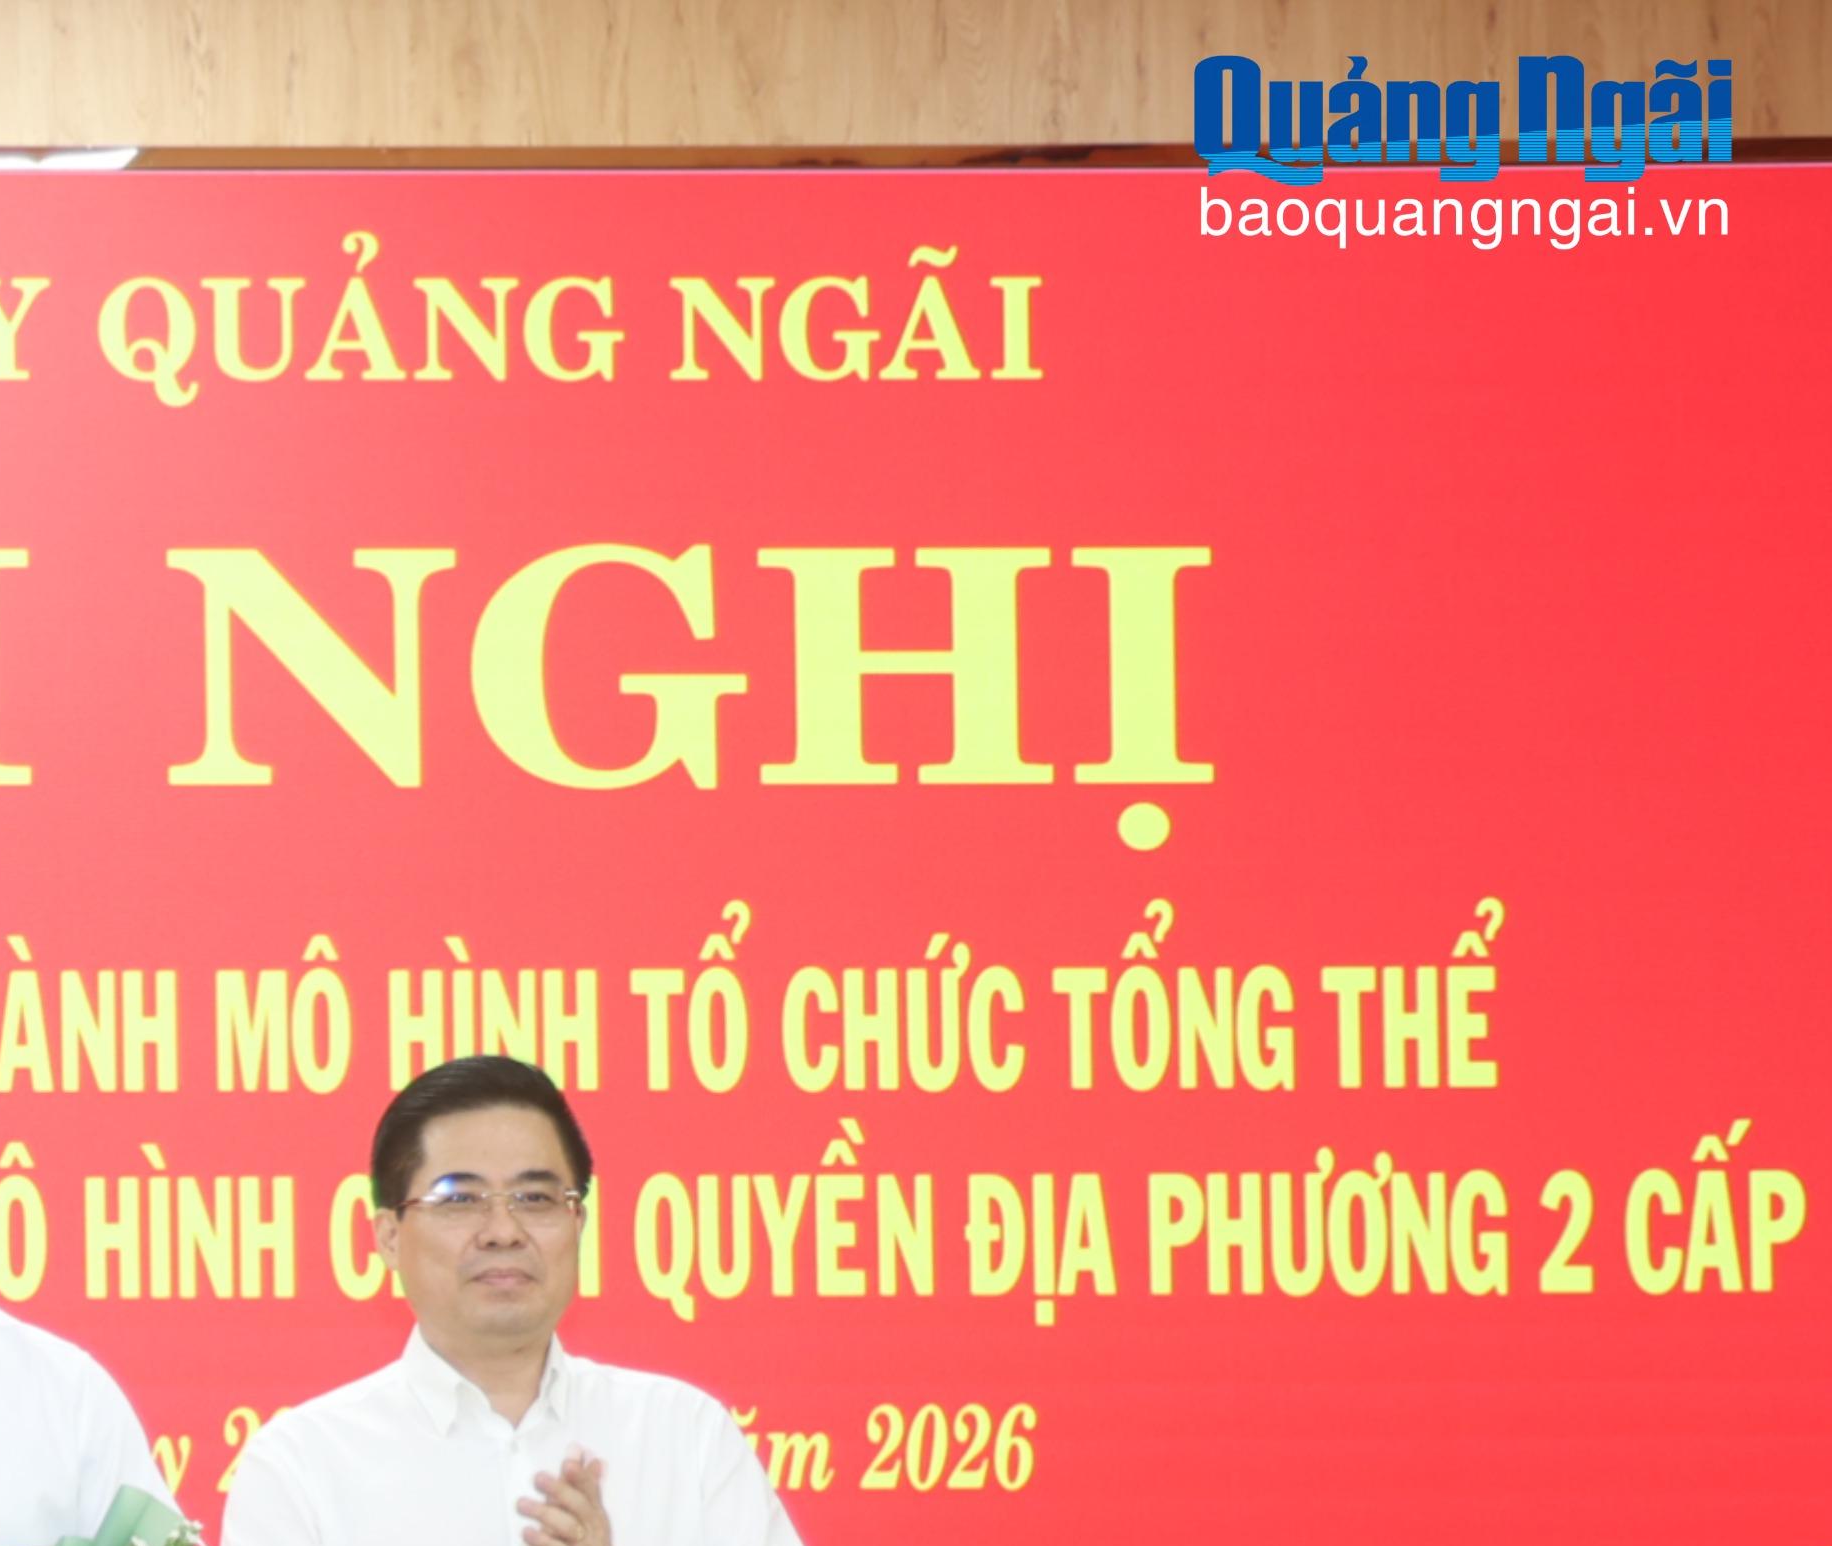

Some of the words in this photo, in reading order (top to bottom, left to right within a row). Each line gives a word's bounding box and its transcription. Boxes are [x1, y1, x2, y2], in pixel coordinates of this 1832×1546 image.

[97, 230, 625, 408] QUẢNG
[670, 245, 1043, 382] NGÃI
[165, 542, 1216, 852] NGHỊ
[214, 934, 352, 1094] MÔ
[388, 936, 600, 1092] HÌNH
[630, 900, 751, 1093] TỔ
[782, 933, 1025, 1093] CHỨC
[1052, 899, 1294, 1091] TỔNG
[1321, 897, 1504, 1088] THỂ
[84, 1143, 297, 1300] HÌNH
[634, 1118, 935, 1321] QUYỀN
[965, 1173, 1117, 1326] ĐỊA
[1148, 1147, 1509, 1296] PHƯƠNG
[1540, 1170, 1594, 1293] 2
[1625, 1119, 1806, 1294] CẤP
[859, 1403, 1037, 1491] 2026
